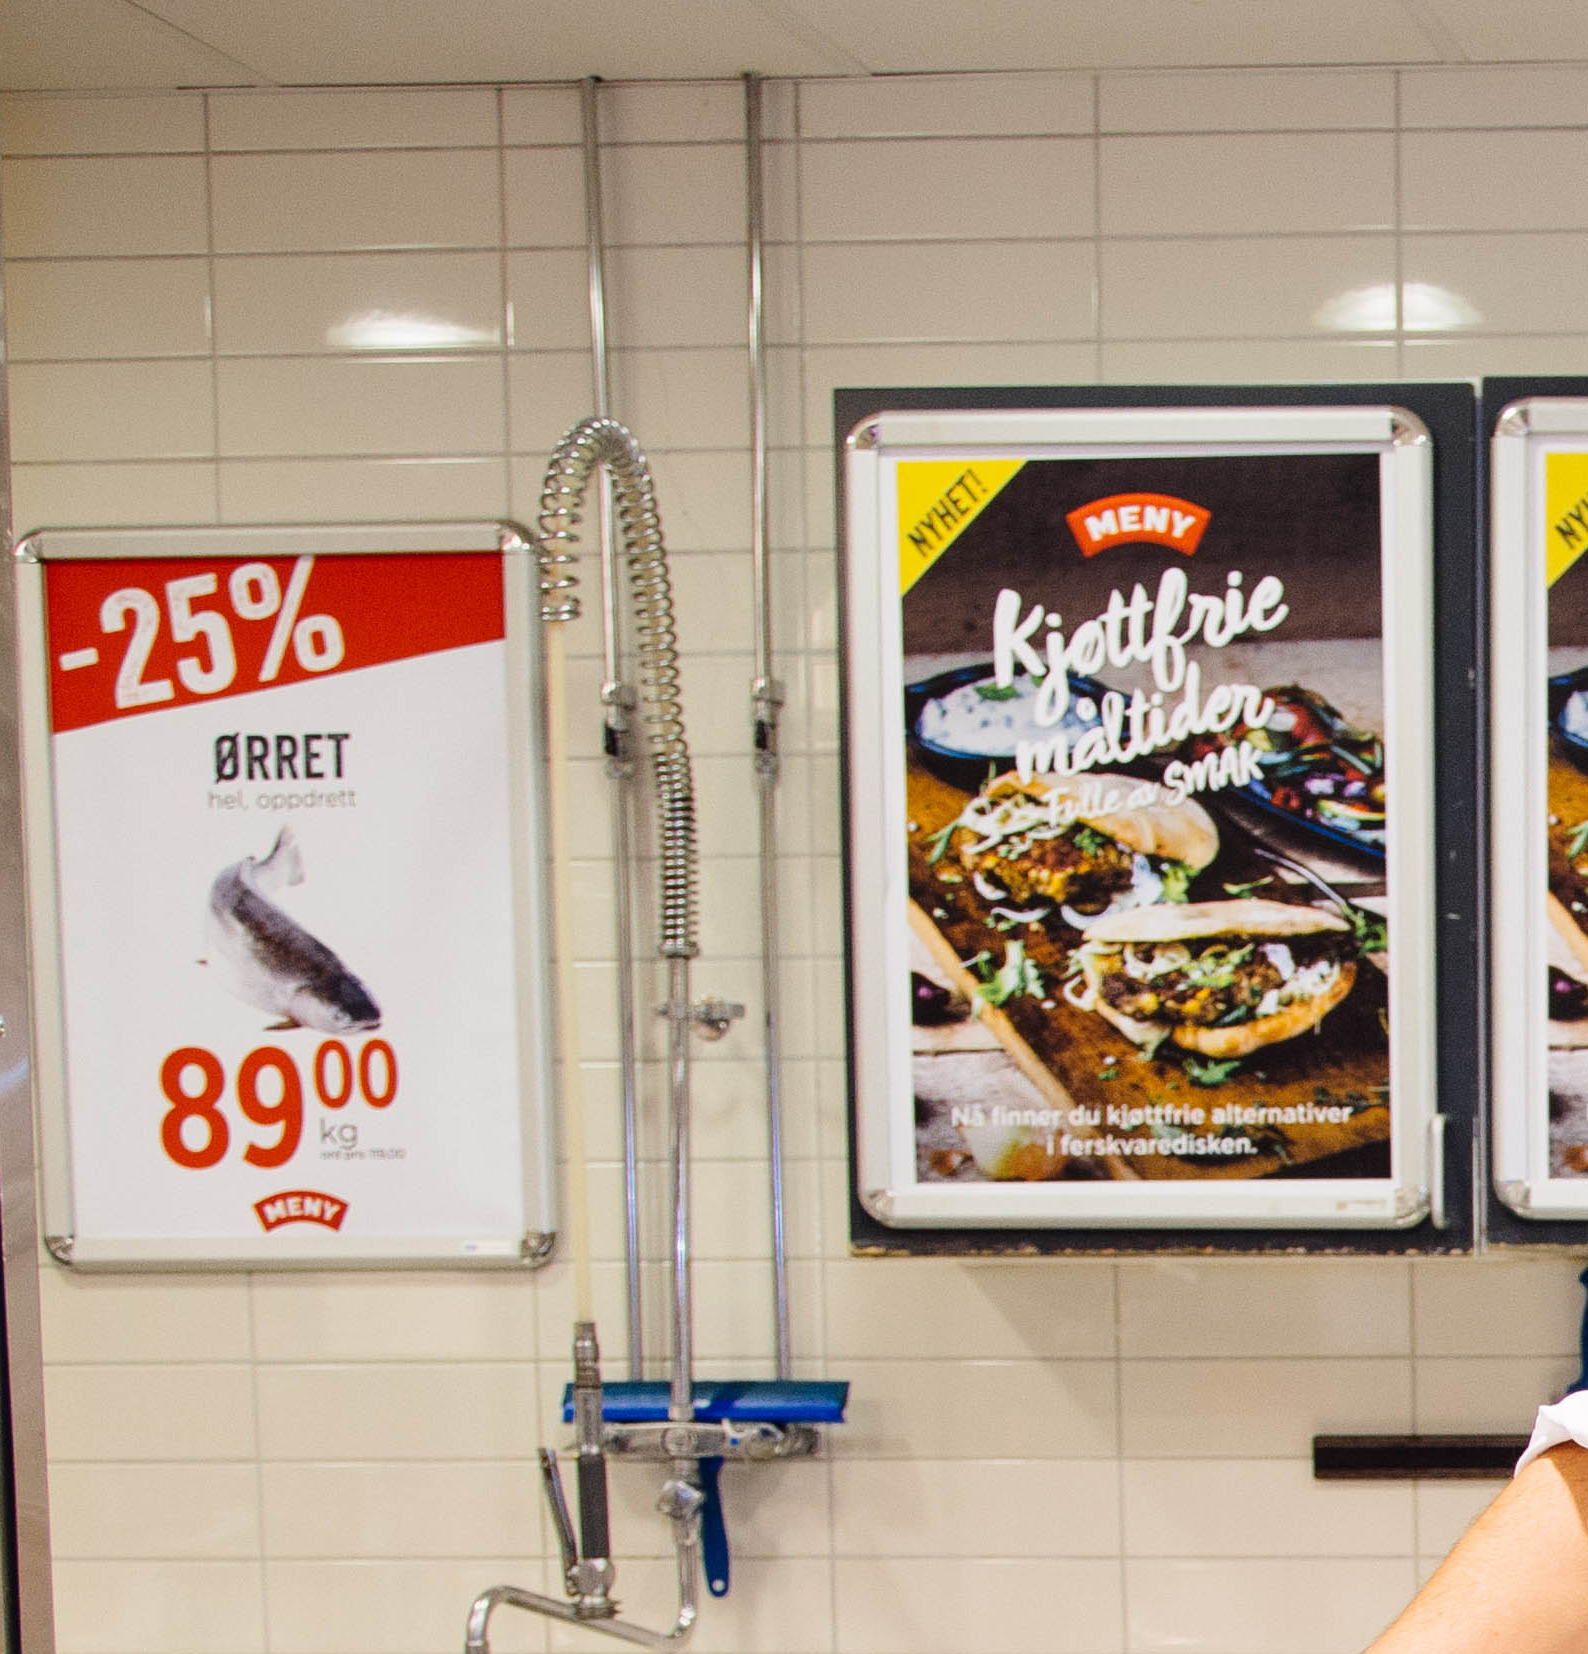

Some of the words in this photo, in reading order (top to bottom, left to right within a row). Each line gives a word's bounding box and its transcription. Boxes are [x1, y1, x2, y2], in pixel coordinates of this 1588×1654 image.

[906, 467, 989, 558] NYHET!
[1083, 504, 1197, 542] MENY
[58, 553, 346, 709] -25%
[992, 566, 1290, 728] Kjøttfrie
[1015, 659, 1276, 785] måltider
[213, 732, 351, 784] ØRRET
[1163, 739, 1265, 807] SMAK
[256, 788, 358, 811] oppdrett
[319, 1117, 358, 1150] kg
[951, 1103, 984, 1128] Nå
[991, 1104, 1063, 1127] finner
[1069, 1104, 1102, 1127] du
[1107, 1102, 1205, 1131] kjøttfrie
[1210, 1101, 1354, 1125] alternativer
[1060, 1132, 1259, 1157] ferskvaredisken.
[263, 1196, 341, 1224] MENY
